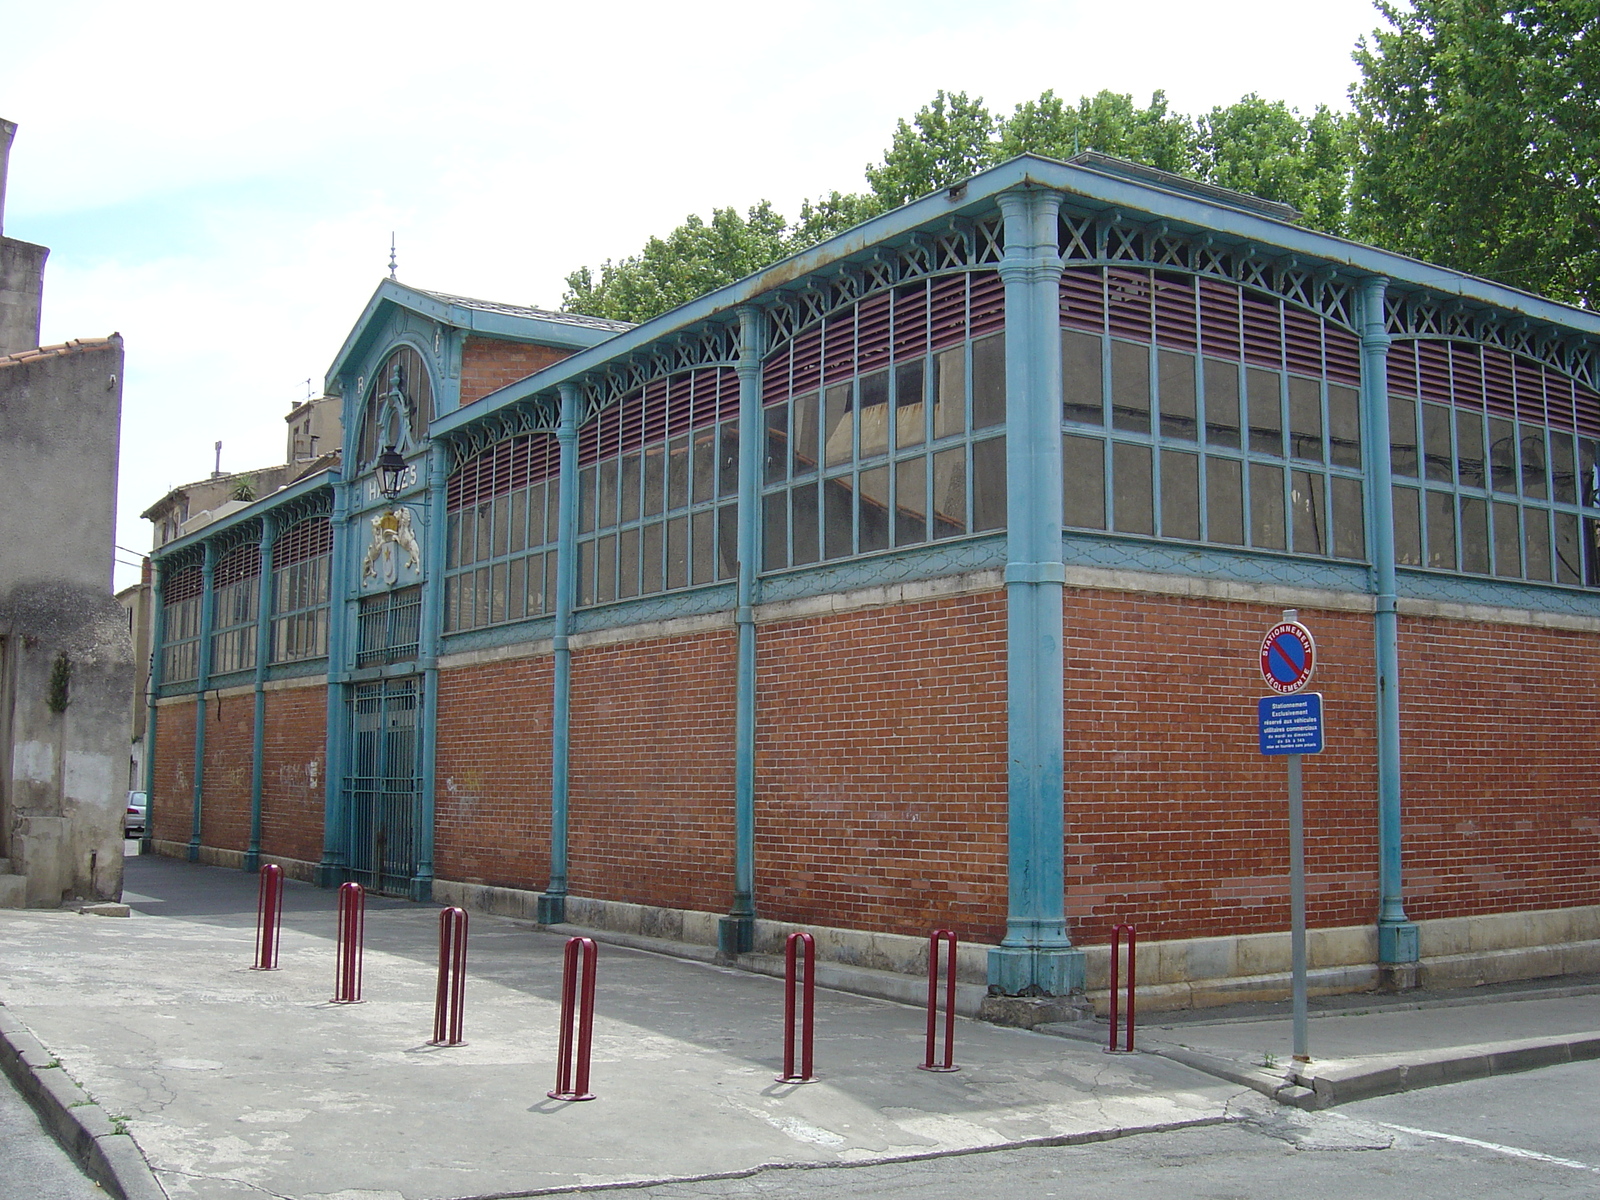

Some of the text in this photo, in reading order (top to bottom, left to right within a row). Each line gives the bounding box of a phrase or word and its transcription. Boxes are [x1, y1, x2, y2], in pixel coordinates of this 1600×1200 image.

[357, 376, 364, 394] R
[369, 465, 417, 501] HLLES
[1262, 625, 1311, 656] STATIONNEMENT
[1265, 668, 1310, 692] REGLEMENTE
